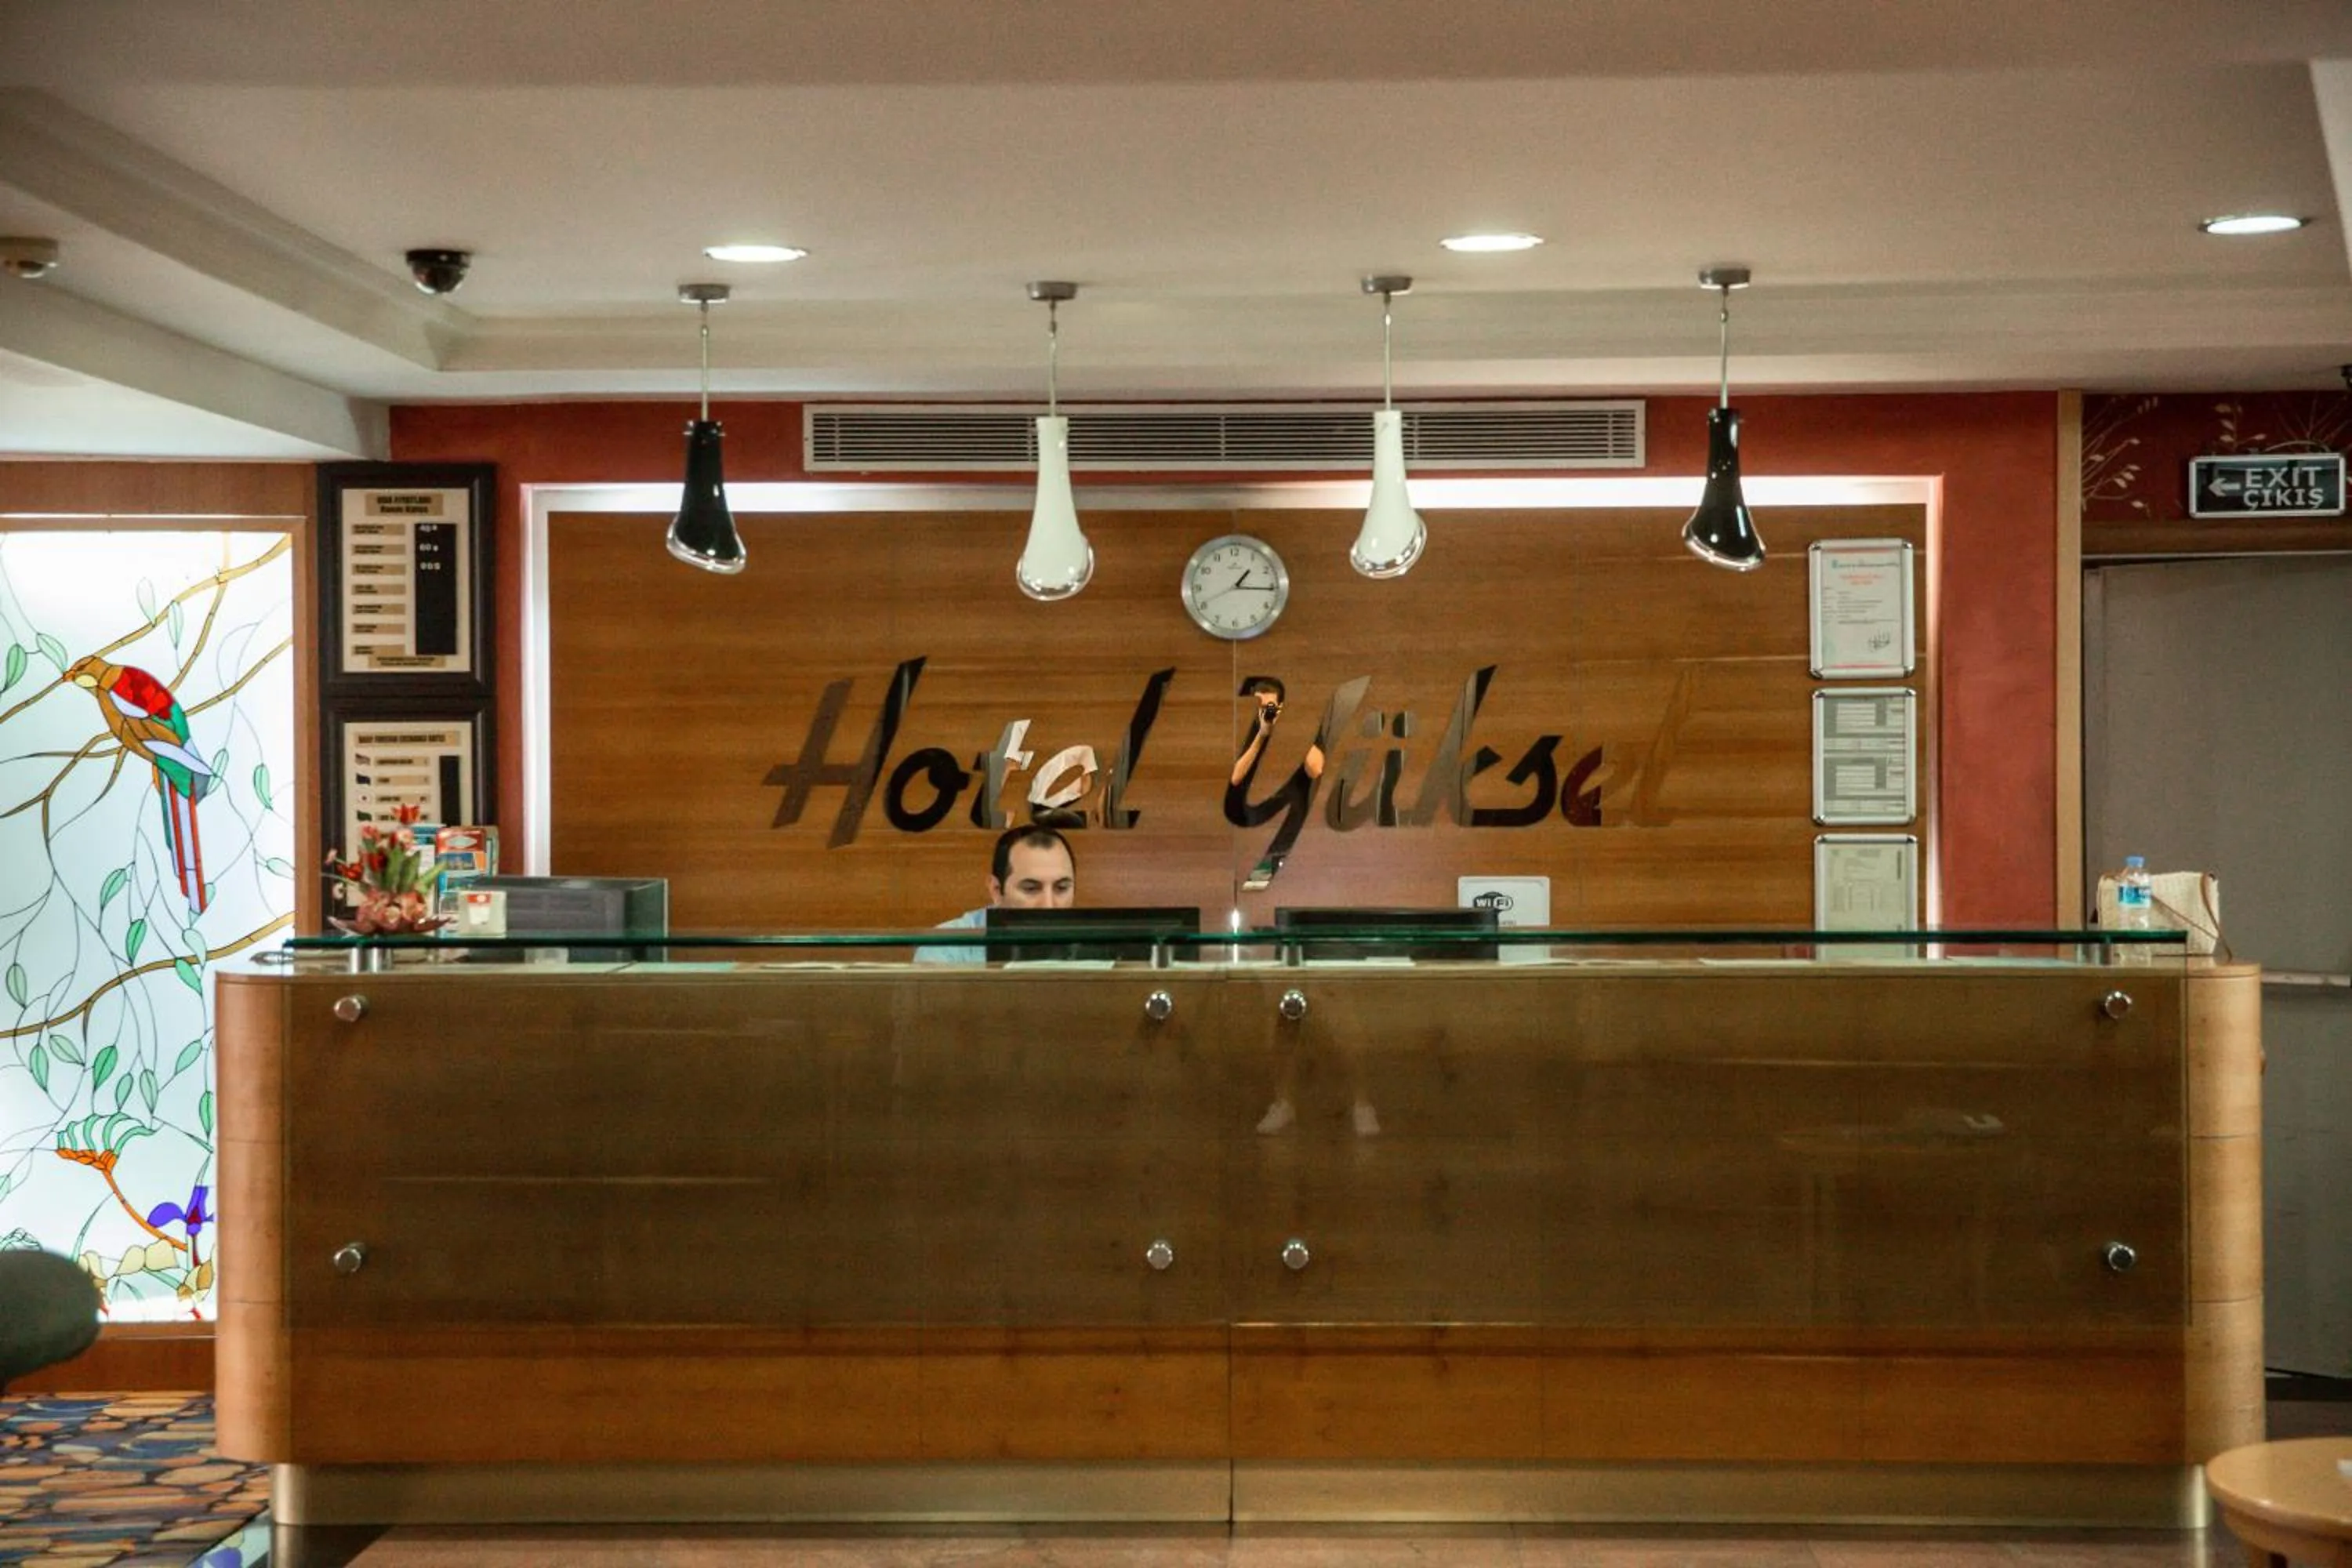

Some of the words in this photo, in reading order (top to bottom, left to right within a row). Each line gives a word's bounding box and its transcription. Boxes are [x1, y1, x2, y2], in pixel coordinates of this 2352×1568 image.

[2245, 466, 2322, 488] EXIT
[2243, 488, 2325, 511] ÇIKIŞ
[762, 655, 1175, 850] Hotel
[1223, 665, 1694, 892] Yüksel
